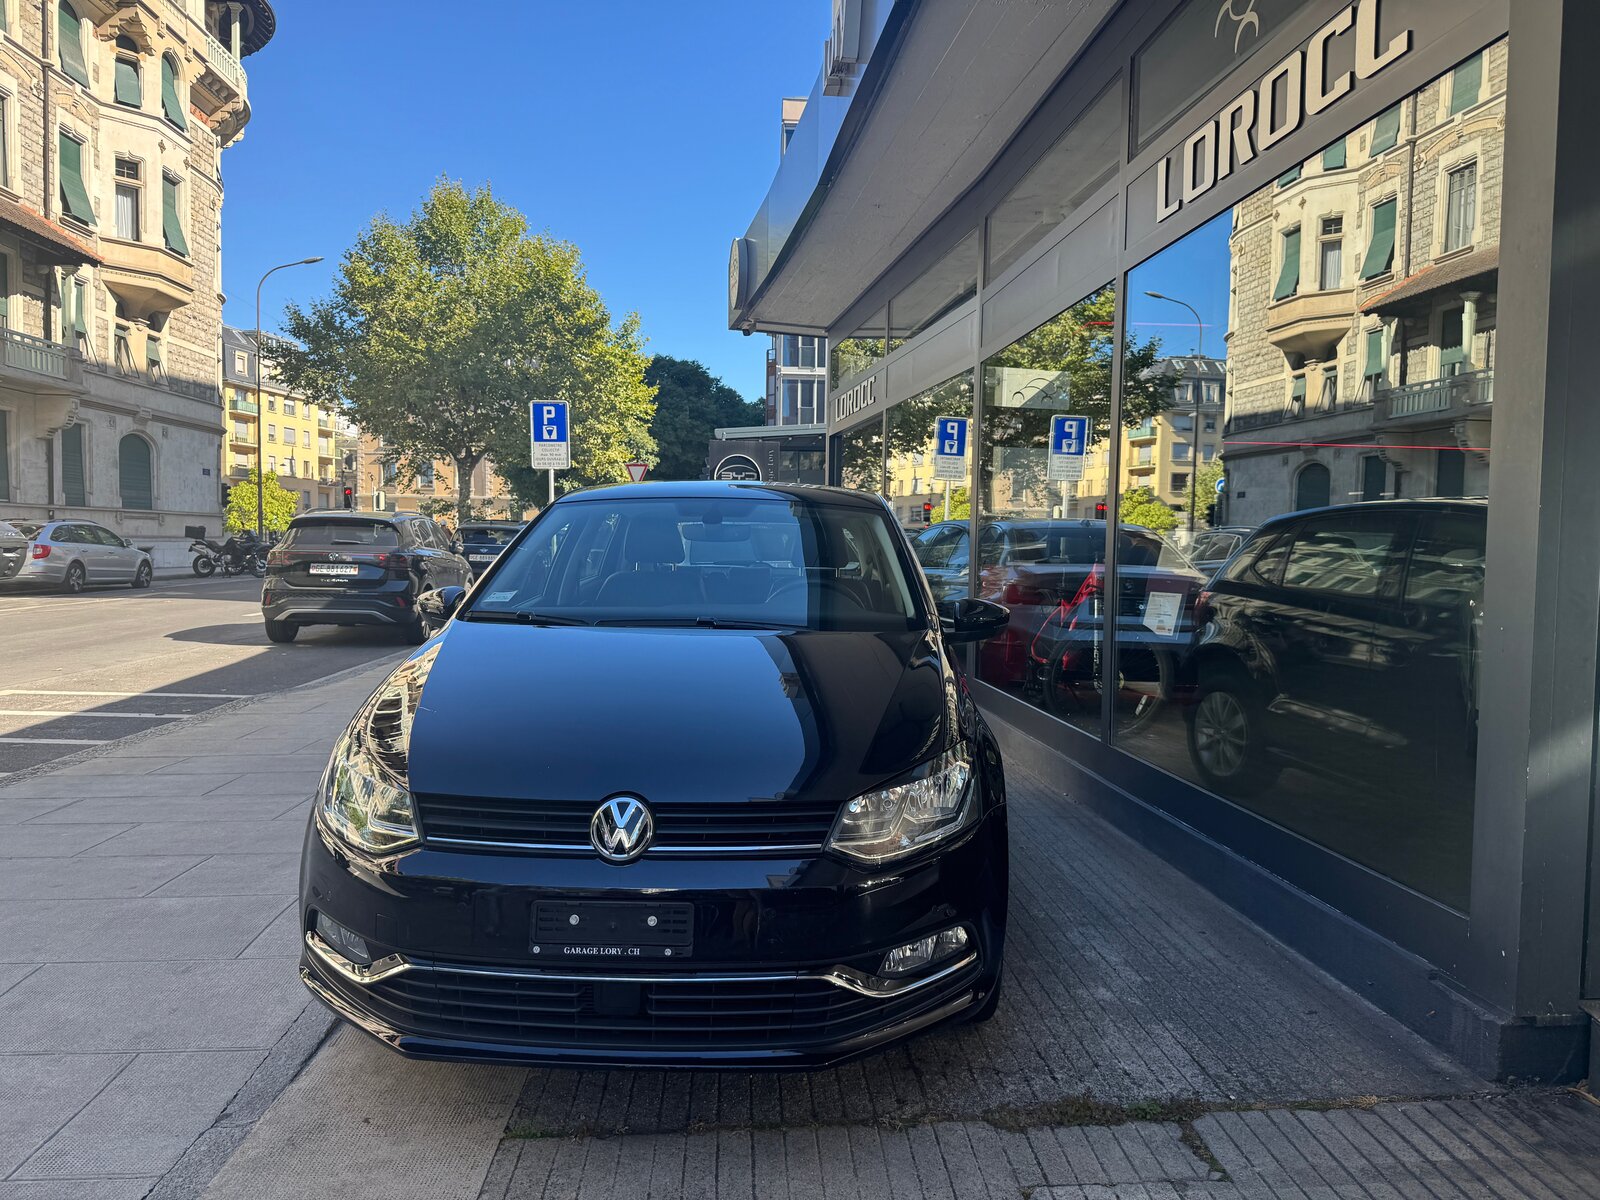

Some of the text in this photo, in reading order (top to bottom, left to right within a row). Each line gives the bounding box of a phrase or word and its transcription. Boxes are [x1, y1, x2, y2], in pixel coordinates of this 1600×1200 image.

[835, 375, 876, 422] LOROCC
[543, 406, 556, 425] P
[563, 946, 599, 955] GARAGE
